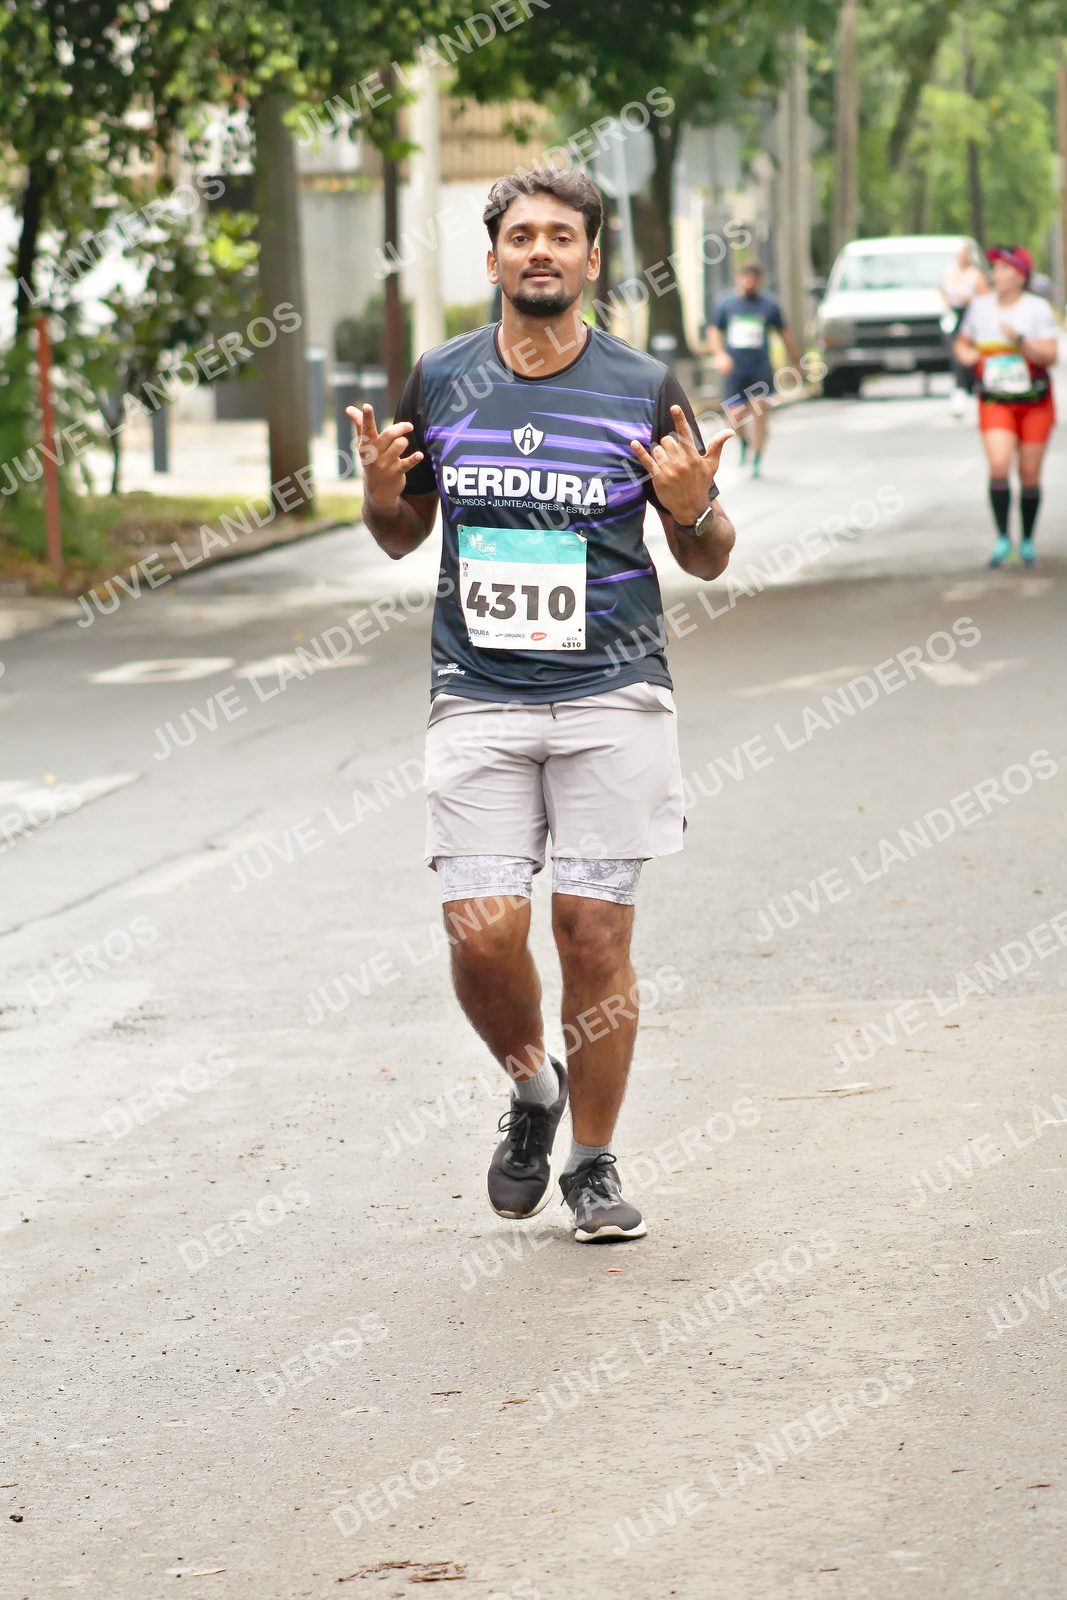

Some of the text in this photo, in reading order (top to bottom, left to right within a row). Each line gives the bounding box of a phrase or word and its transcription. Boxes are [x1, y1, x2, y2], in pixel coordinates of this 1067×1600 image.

[443, 466, 606, 506] PERDURA
[462, 498, 486, 507] PISOS
[493, 500, 559, 511] JUNTEADORES
[566, 506, 605, 515] ESTUCOS
[466, 581, 576, 621] 4310
